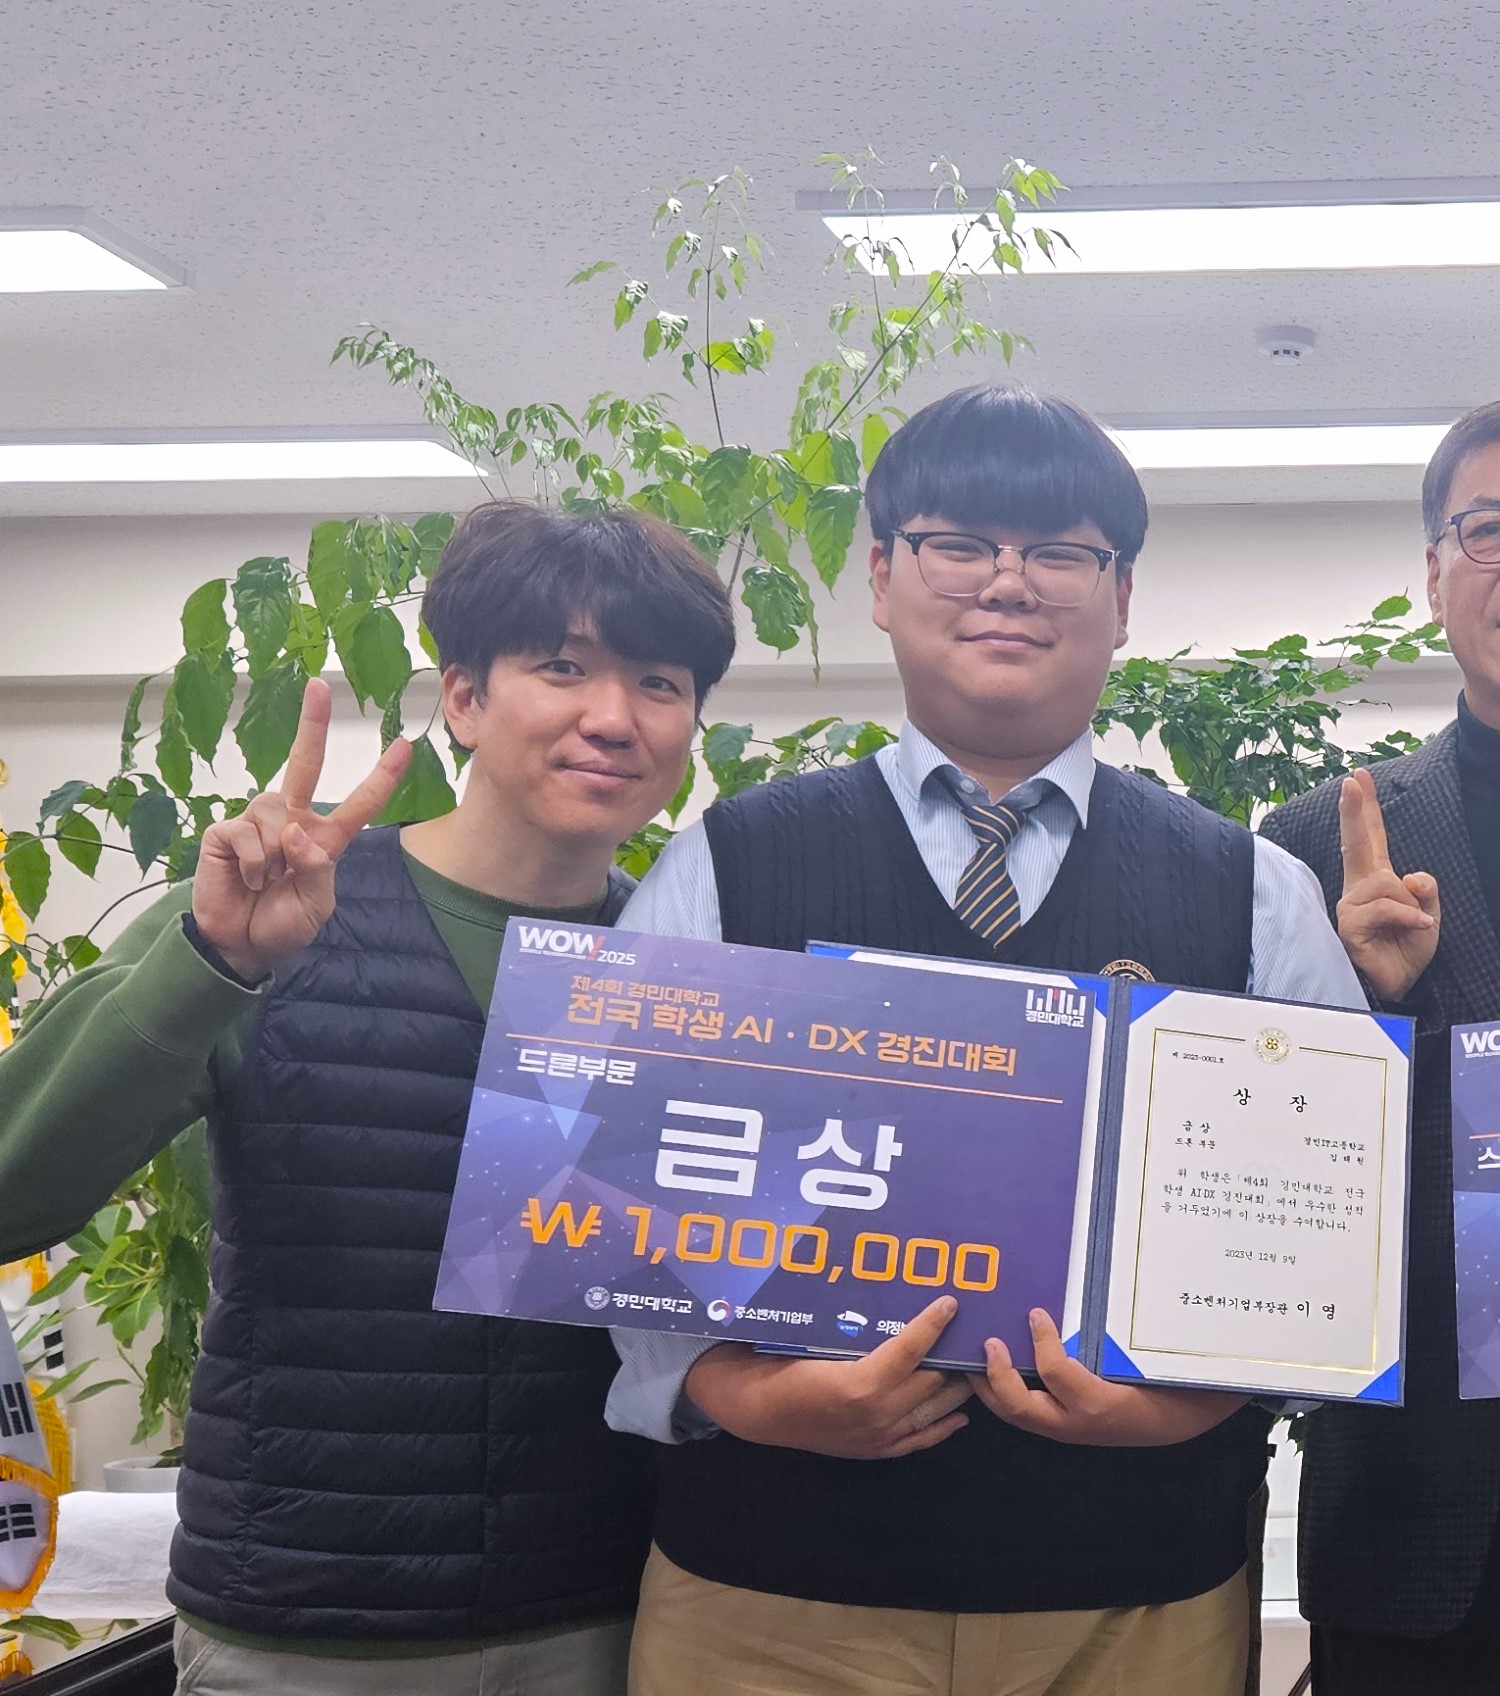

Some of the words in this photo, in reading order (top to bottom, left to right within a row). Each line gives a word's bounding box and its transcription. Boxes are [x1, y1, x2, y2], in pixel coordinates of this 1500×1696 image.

[596, 949, 637, 966] 2025
[570, 975, 624, 996] 제4회
[627, 981, 721, 1008] 경민대학교
[1025, 1009, 1085, 1028] 경민대학교
[567, 993, 642, 1031] 전국
[652, 1003, 725, 1041] 학생
[731, 1015, 775, 1044] AI
[808, 1023, 869, 1056] DX
[877, 1031, 1017, 1077] 경진대회
[517, 1048, 638, 1086] 드론부문
[1280, 1179, 1334, 1195] 경민대학교
[1163, 1184, 1183, 1197] 학생
[1304, 1199, 1337, 1214] 우수한
[1256, 1212, 1287, 1226] 상장을
[624, 1206, 1000, 1292] 1,000,000
[612, 1292, 693, 1315] 경민대학교
[734, 1306, 814, 1326] 중소벤처기업부
[876, 1319, 908, 1336] 의정
